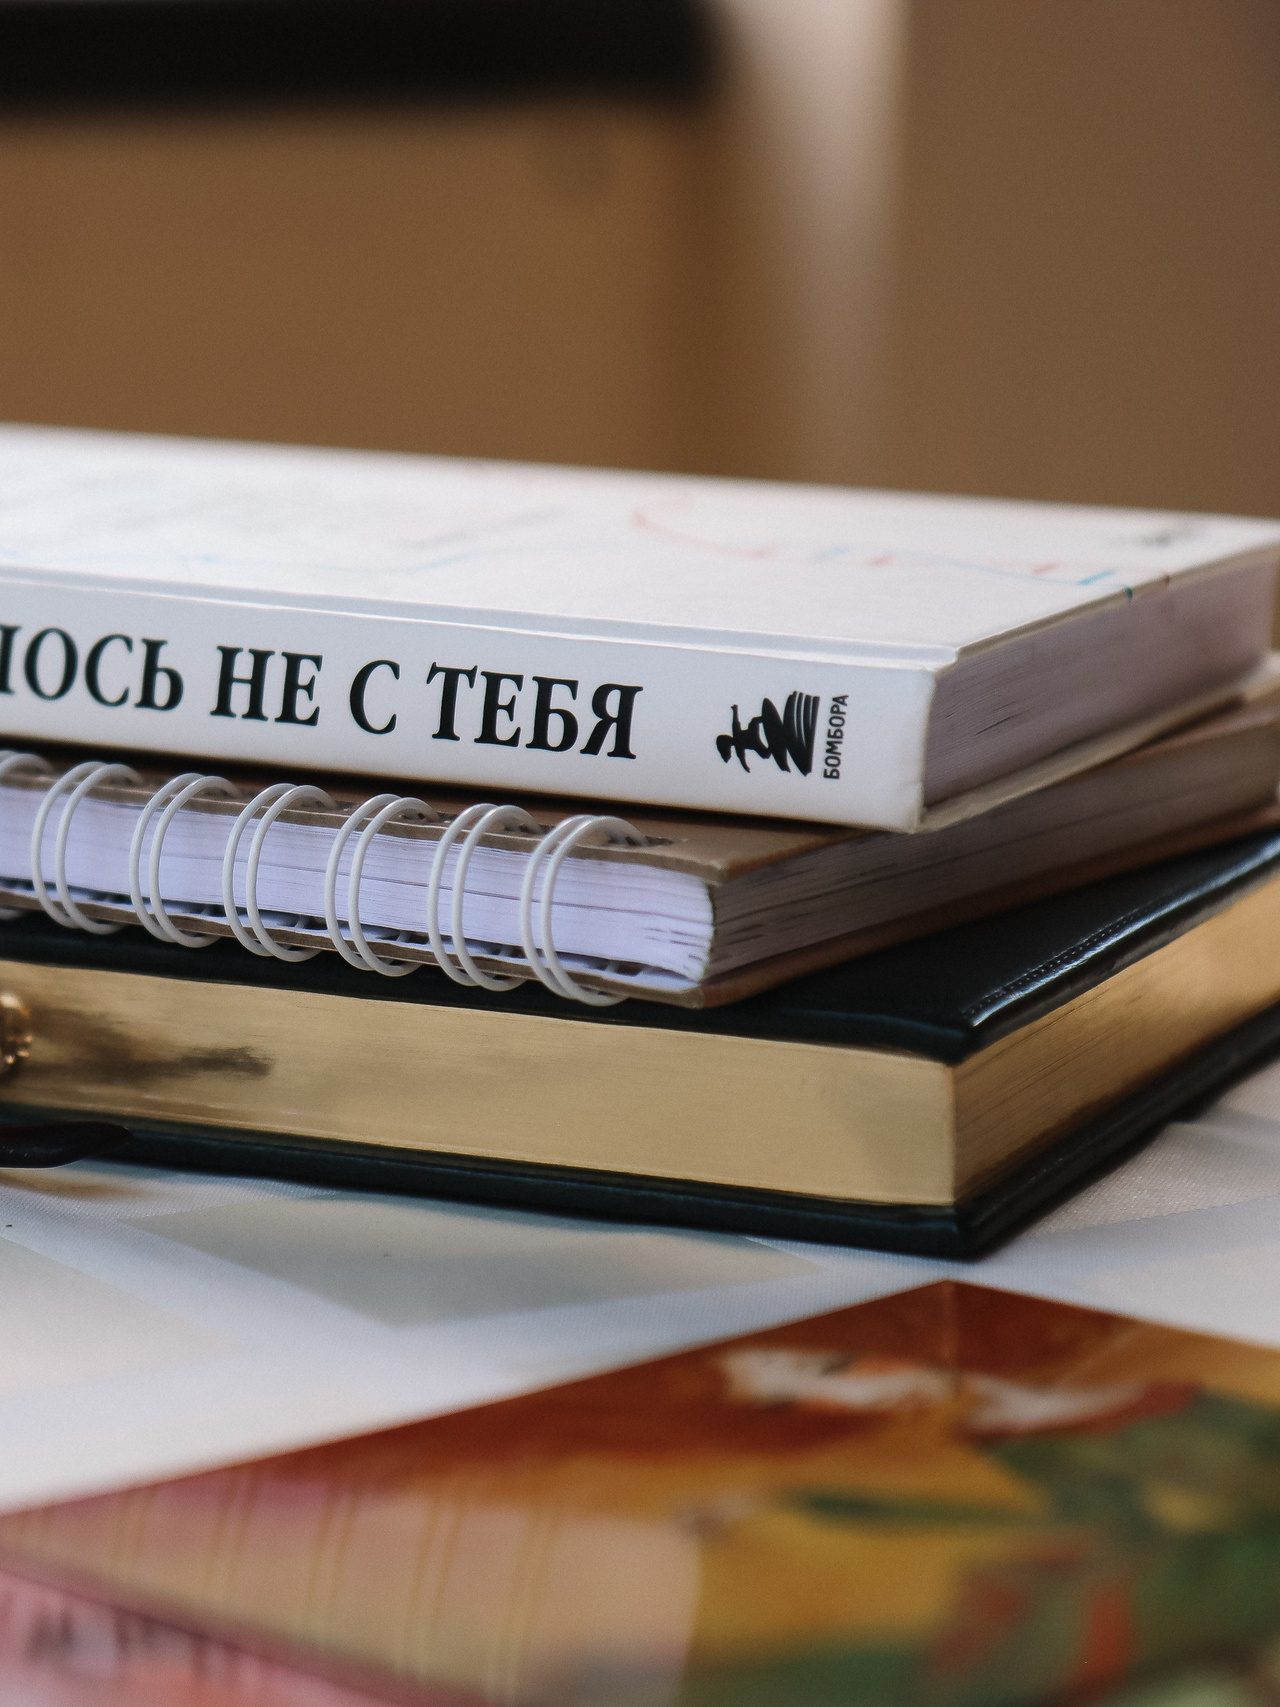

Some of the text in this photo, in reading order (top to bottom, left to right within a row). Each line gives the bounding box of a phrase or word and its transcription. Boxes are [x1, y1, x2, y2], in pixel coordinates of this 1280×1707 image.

[208, 644, 324, 728] НЕ
[348, 658, 401, 736] С
[425, 661, 645, 761] ТЕБЯ
[822, 694, 850, 781] БОМБОРА
